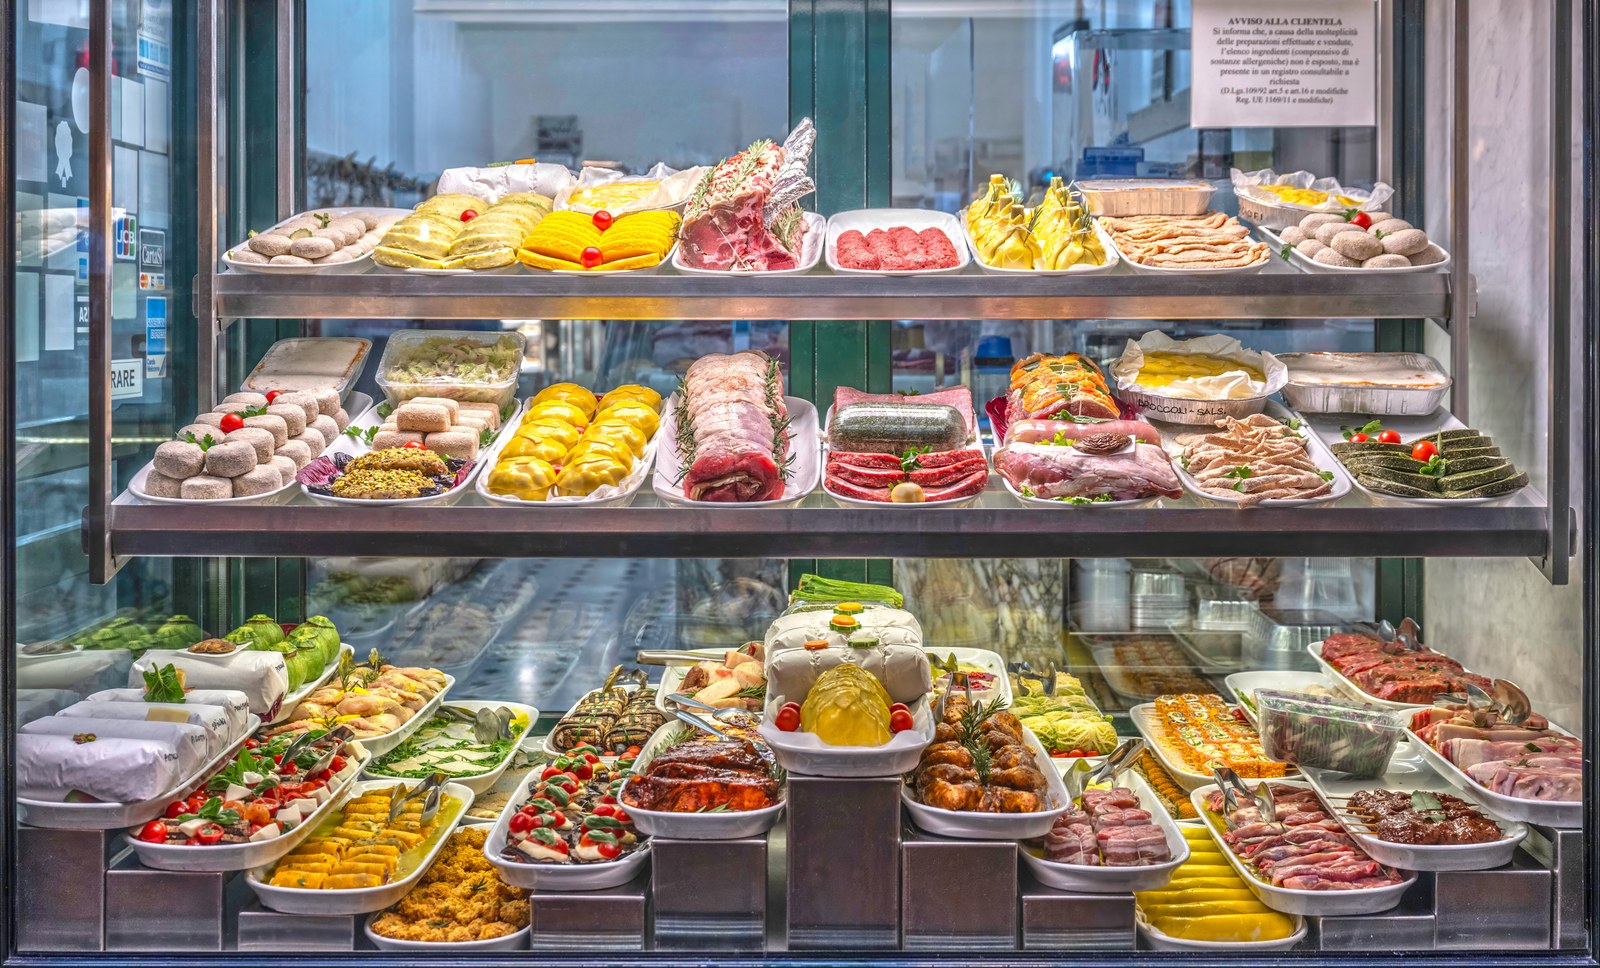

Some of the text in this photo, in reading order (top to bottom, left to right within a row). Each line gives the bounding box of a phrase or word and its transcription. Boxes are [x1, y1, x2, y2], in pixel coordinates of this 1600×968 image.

[1228, 17, 1343, 26] AVVISO ALLA CLIENTELA
[1212, 27, 1221, 35] Si
[1222, 27, 1251, 35] informa
[1252, 28, 1267, 37] che,
[1296, 27, 1314, 35] della
[1315, 28, 1358, 37] molteplicità
[1216, 37, 1235, 45] delle
[1236, 38, 1280, 47] preparazioni
[1281, 38, 1316, 46] effettuate
[1323, 39, 1354, 47] vendute,
[1251, 47, 1290, 57] ingredienti
[1291, 48, 1340, 57] (comprensivo
[1341, 48, 1349, 56] di
[1242, 57, 1289, 66] allergeniche)
[1311, 59, 1341, 67] esposto,
[1220, 68, 1250, 77] presente
[1271, 68, 1299, 77] registro
[1300, 67, 1344, 76] consultabile
[1269, 78, 1300, 86] richiesta
[1235, 96, 1251, 104] Reg.
[1298, 97, 1334, 105] modifiche)
[116, 230, 135, 244] JCB
[142, 245, 162, 265] CartaSi
[111, 369, 135, 388] RARE
[1138, 398, 1187, 414] BROCCOLI
[1196, 407, 1227, 416] SALS.
